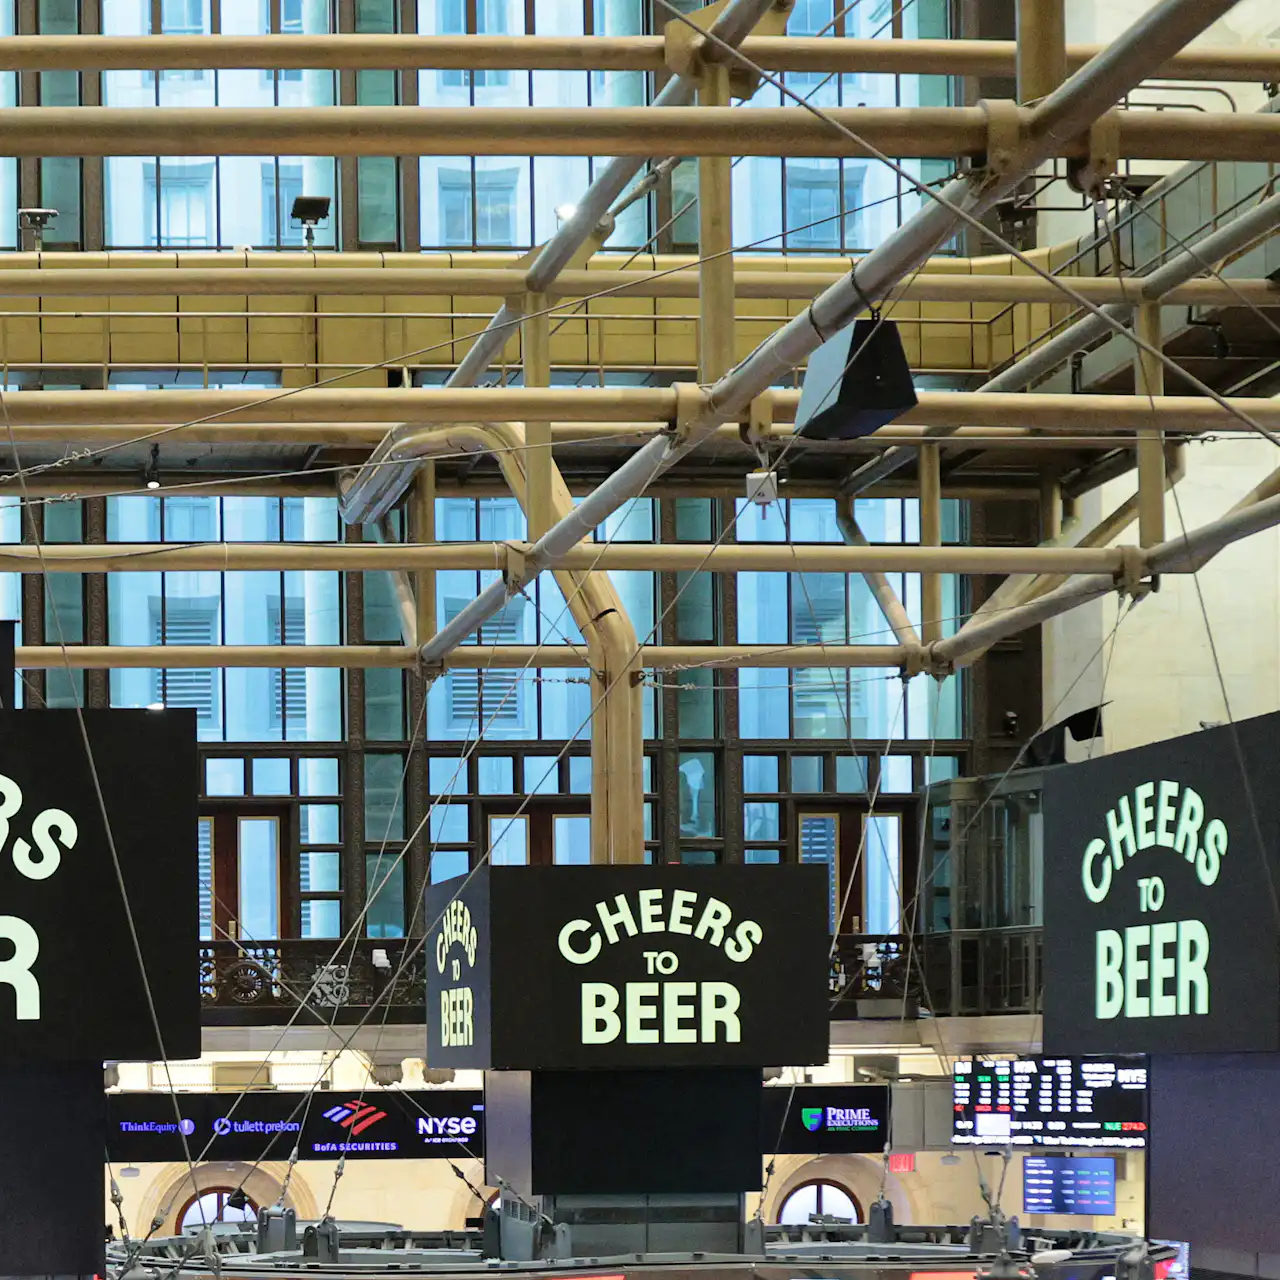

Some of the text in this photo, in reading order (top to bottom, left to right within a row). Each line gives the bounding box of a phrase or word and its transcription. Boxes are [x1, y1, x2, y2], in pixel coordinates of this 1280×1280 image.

[1082, 780, 1228, 903] CHEERS
[1137, 876, 1164, 912] TO
[436, 900, 478, 974] CHEERS
[558, 888, 763, 965] CHEERS
[452, 959, 460, 981] TO
[643, 951, 680, 974] TO
[1096, 920, 1210, 1019] BEER
[441, 987, 473, 1047] BEER
[581, 982, 741, 1044] BEER
[120, 1122, 177, 1134] ThinkEquity
[234, 1121, 299, 1134] tullett prebon
[826, 1107, 871, 1120] PRIME
[827, 1119, 879, 1127] EXECUTIONS
[339, 1142, 397, 1151] SECURITIES
